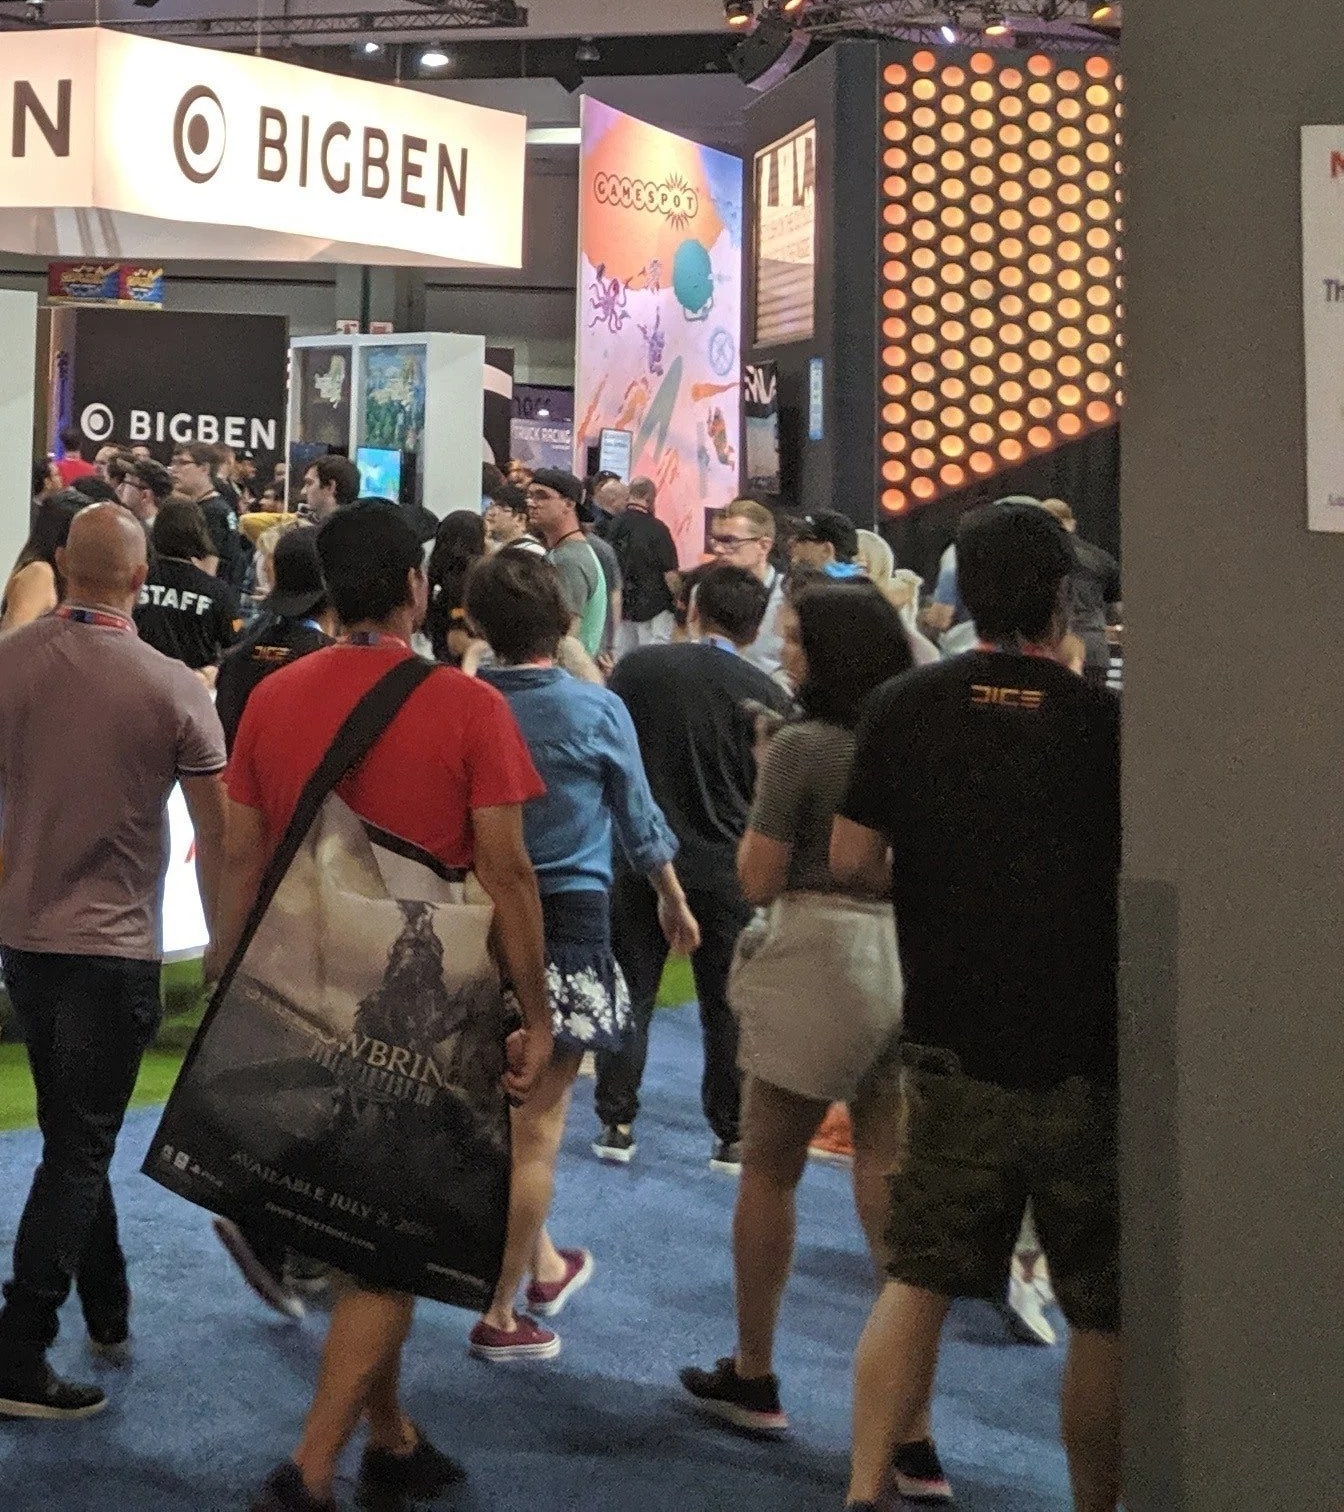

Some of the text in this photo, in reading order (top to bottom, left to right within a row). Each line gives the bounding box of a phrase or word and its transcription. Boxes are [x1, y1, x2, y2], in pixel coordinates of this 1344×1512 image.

[256, 105, 469, 217] BIGBEN
[596, 176, 697, 214] GAMESPOT
[130, 410, 277, 451] BIGBEN
[139, 584, 214, 616] STAFF
[970, 683, 1043, 708] DICE
